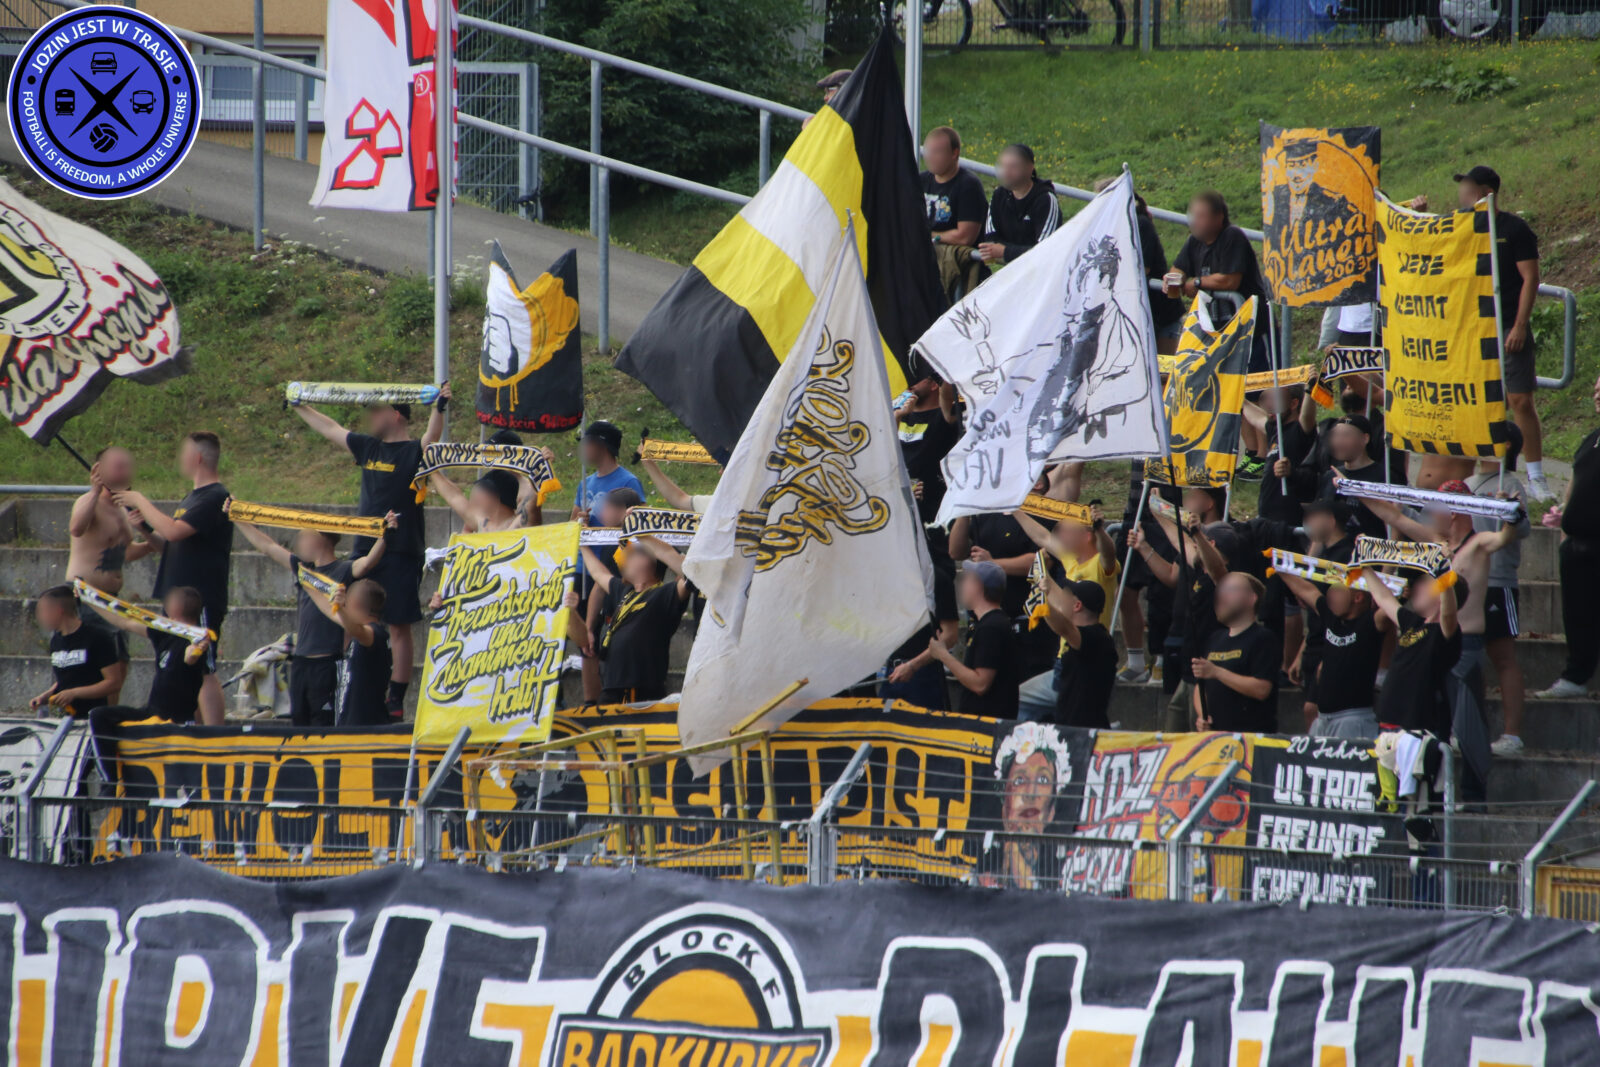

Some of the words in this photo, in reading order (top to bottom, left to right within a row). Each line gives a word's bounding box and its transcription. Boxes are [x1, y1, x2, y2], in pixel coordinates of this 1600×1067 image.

[1265, 233, 1375, 300] Plauen
[1324, 256, 1367, 283] 2003
[1394, 292, 1449, 319] KENNT
[1402, 335, 1449, 361] KEINE
[431, 559, 576, 645] Freundschaft
[489, 619, 532, 650] und
[1273, 763, 1377, 813] ULTRAS
[622, 931, 761, 992] BLOCK
[762, 977, 781, 999] F
